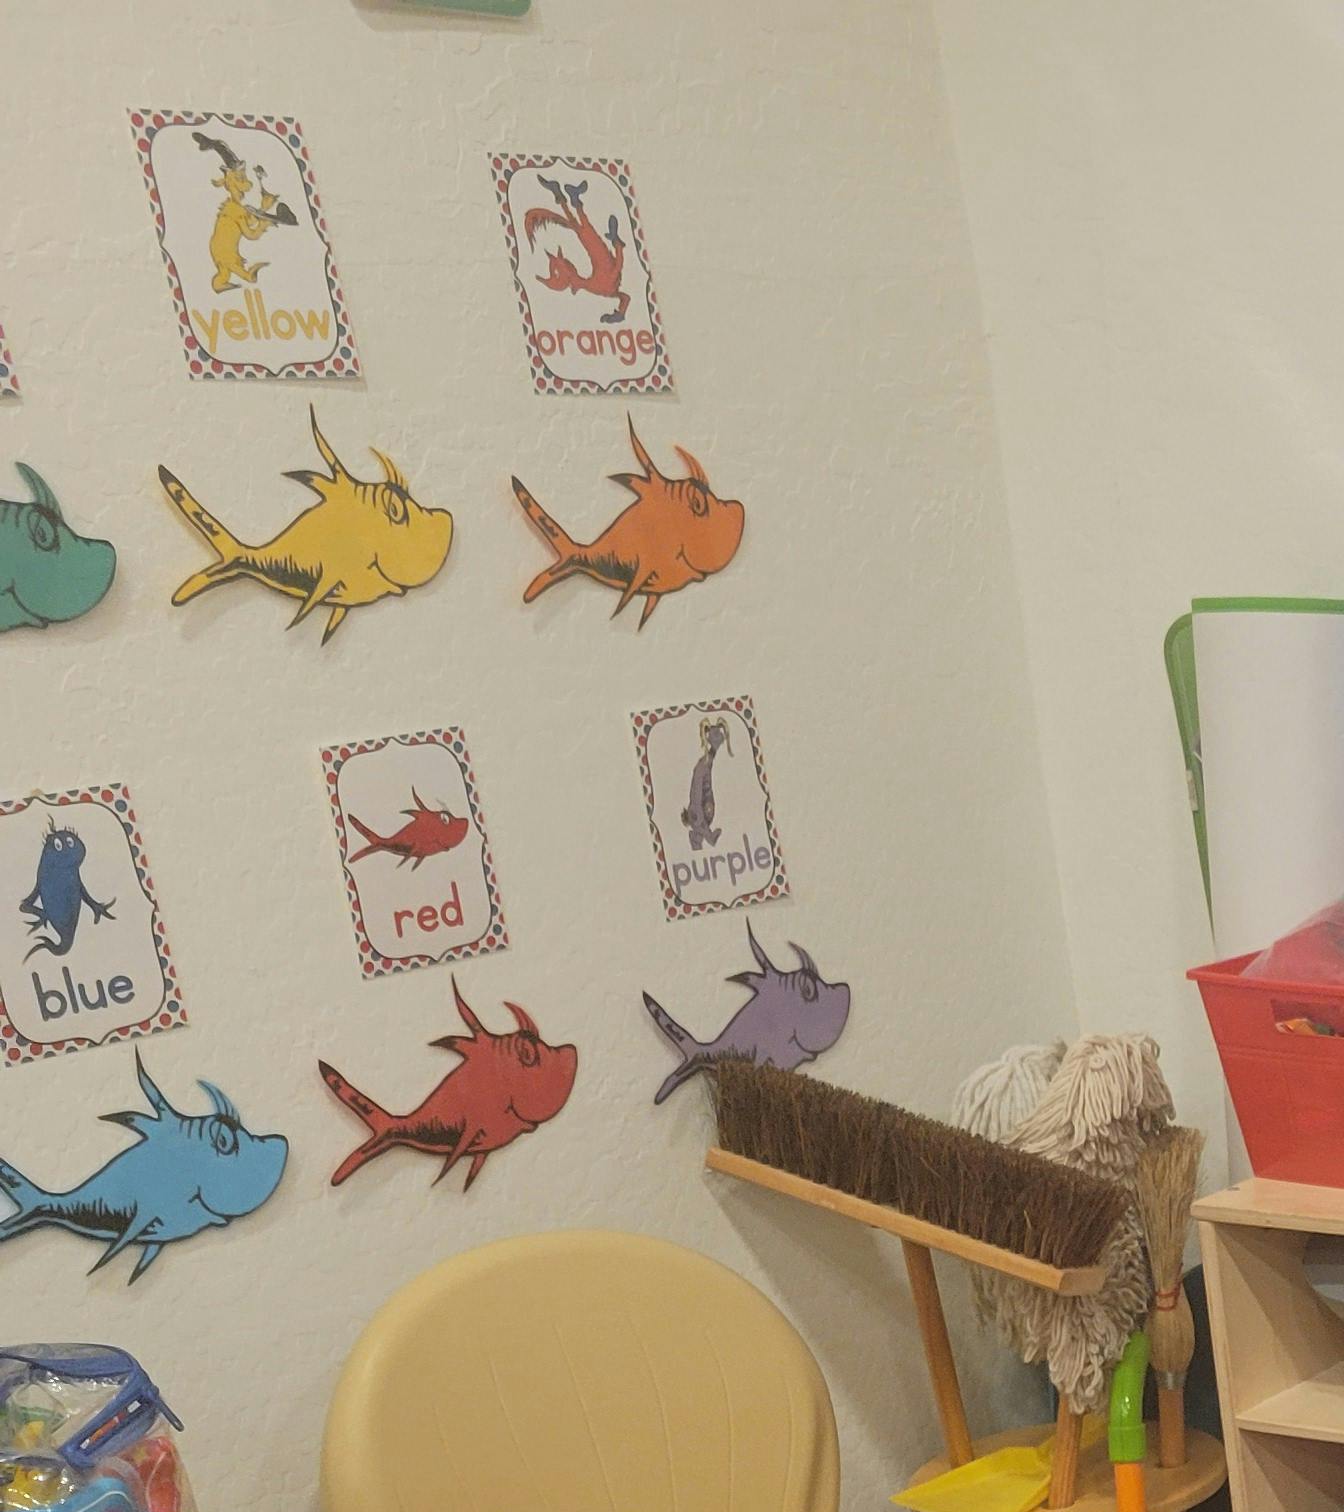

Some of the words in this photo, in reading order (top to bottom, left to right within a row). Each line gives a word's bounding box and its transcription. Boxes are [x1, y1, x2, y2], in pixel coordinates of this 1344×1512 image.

[191, 288, 331, 353] yellow
[535, 328, 654, 366] orange
[673, 833, 771, 898] purple
[394, 881, 464, 938] red
[32, 966, 135, 1022] blue
